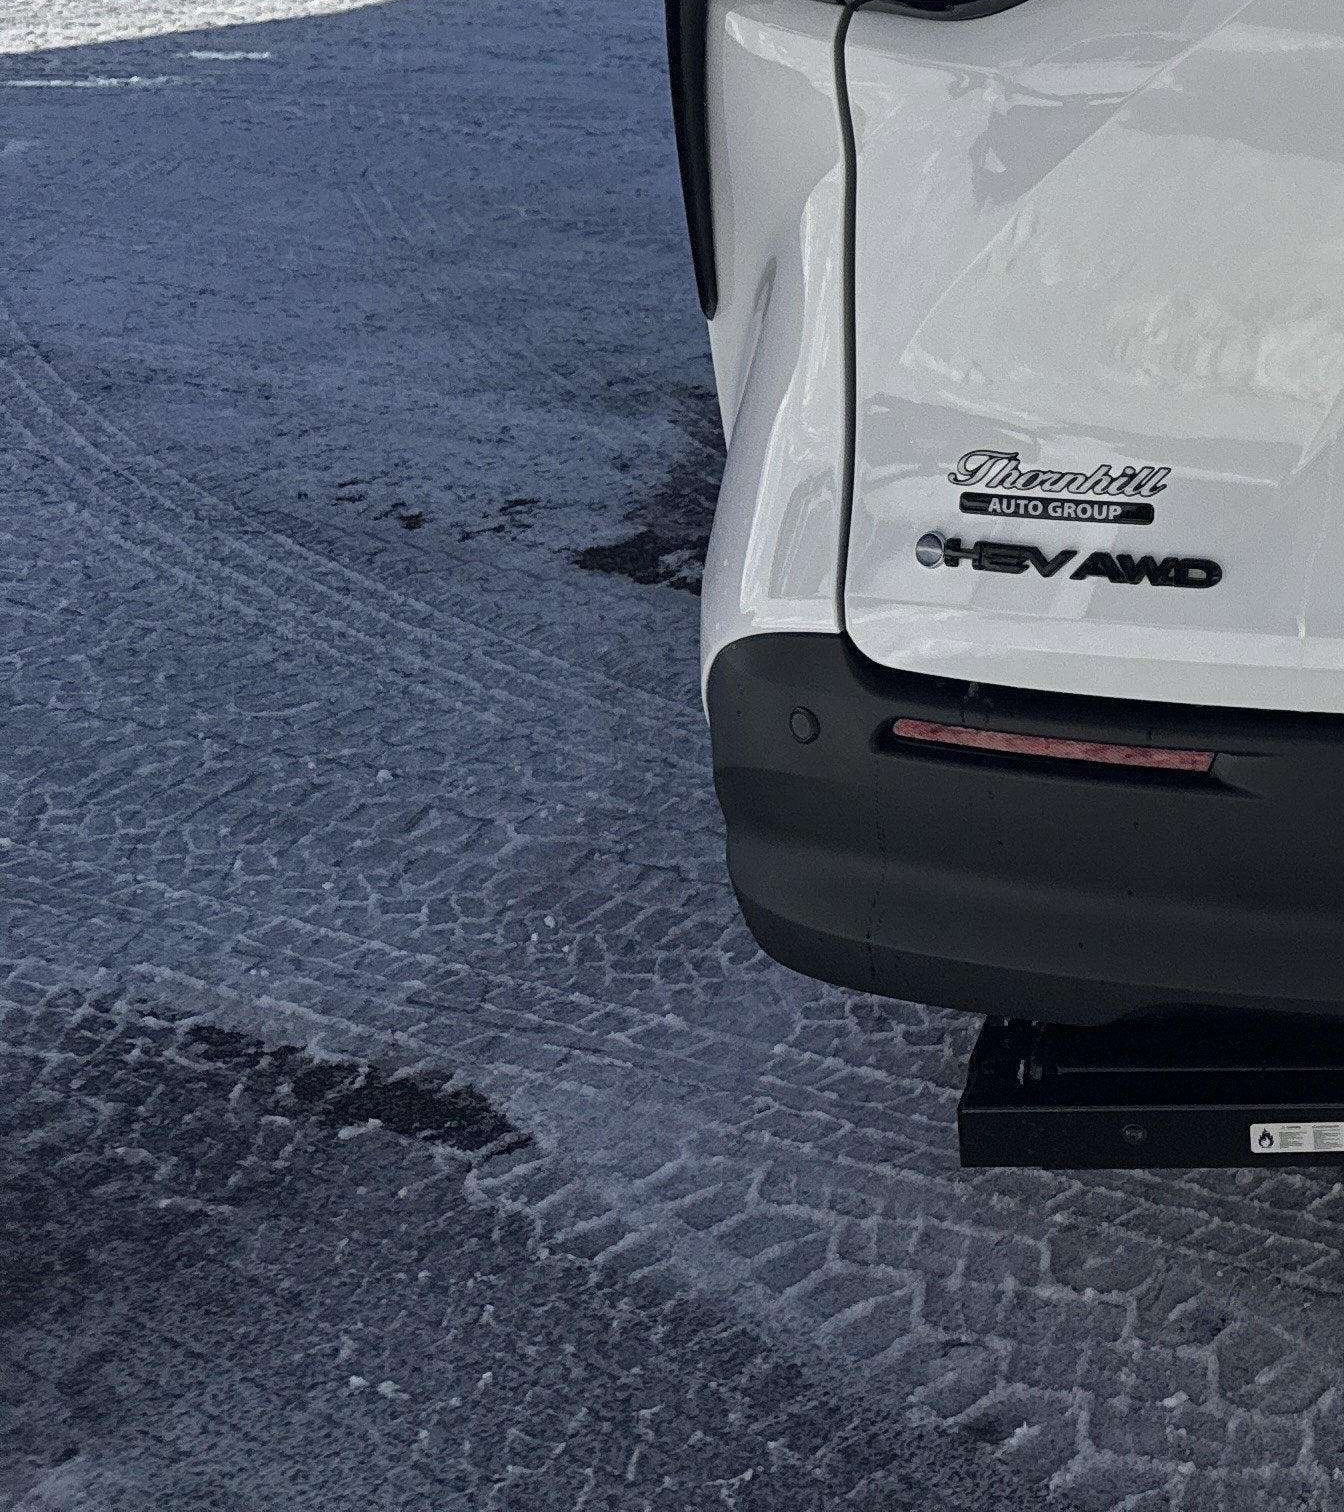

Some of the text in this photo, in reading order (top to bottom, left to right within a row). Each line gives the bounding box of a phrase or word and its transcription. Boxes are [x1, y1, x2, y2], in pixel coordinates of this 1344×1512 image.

[947, 449, 1172, 498] Thornhill
[986, 497, 1123, 521] AUTO GROUP
[1069, 551, 1224, 589] AWD
